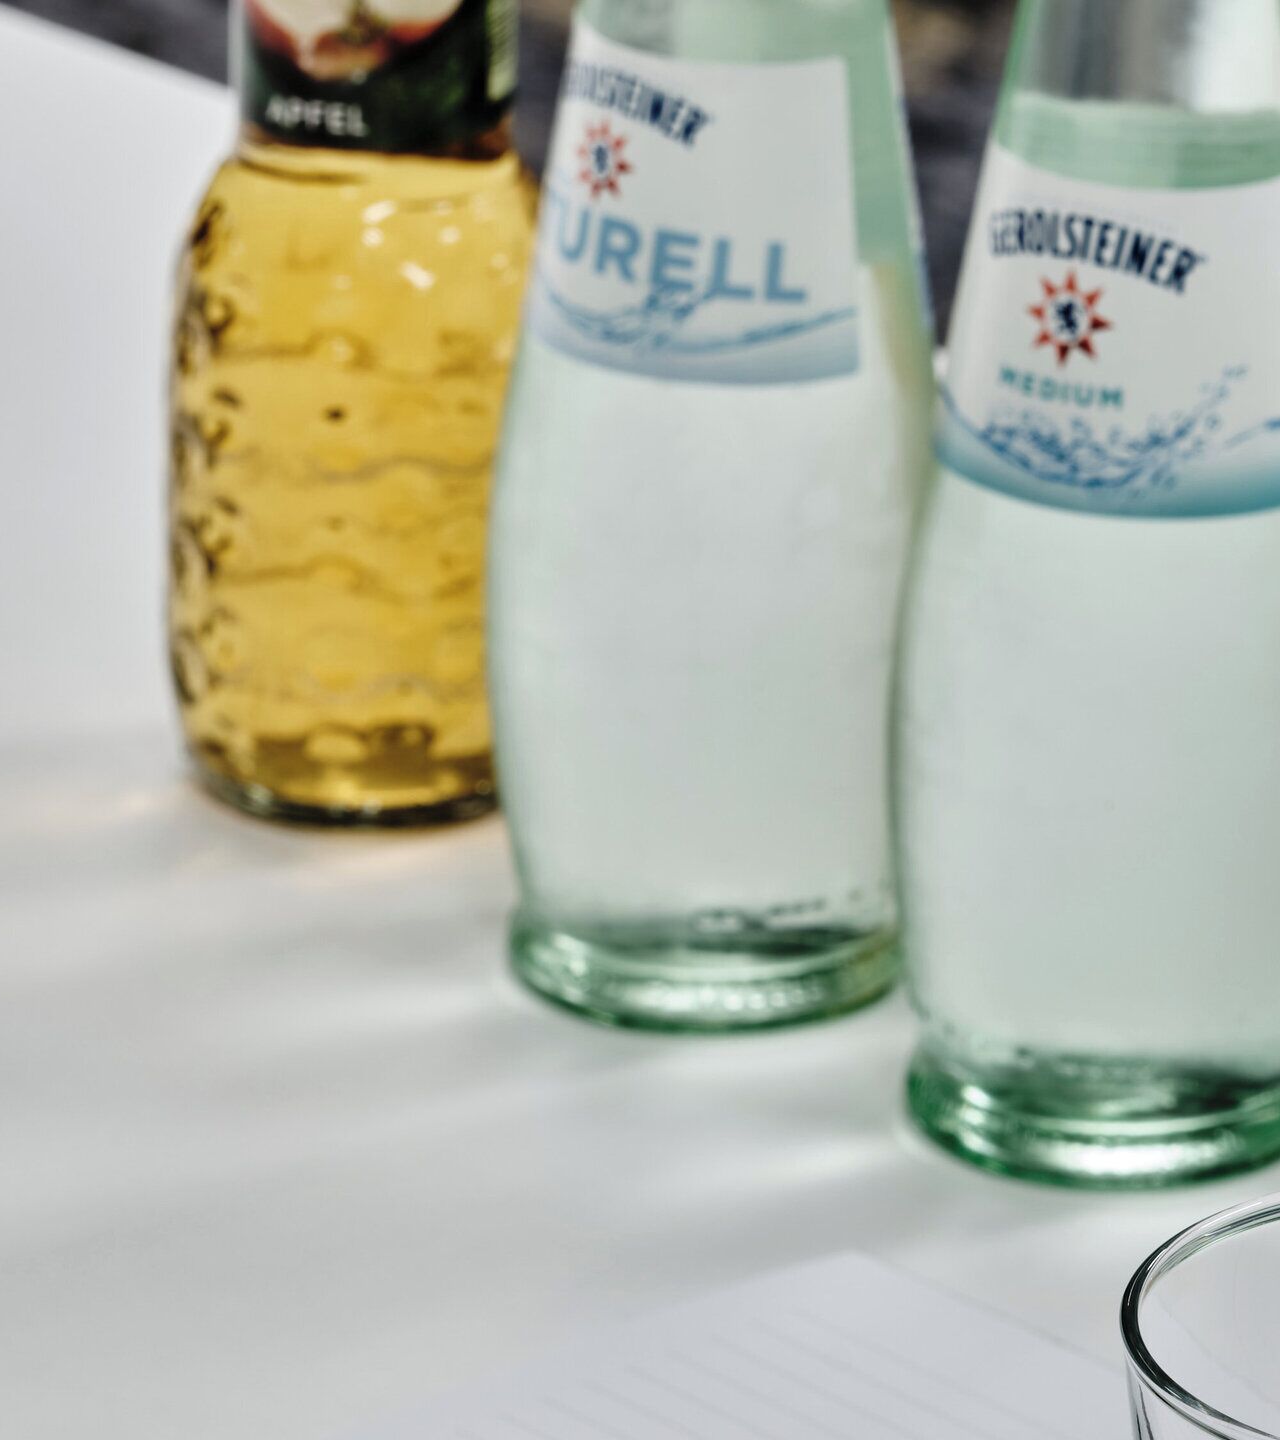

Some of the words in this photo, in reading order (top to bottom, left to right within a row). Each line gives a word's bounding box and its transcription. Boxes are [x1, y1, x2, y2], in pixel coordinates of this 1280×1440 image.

[266, 95, 368, 137] APFEL
[558, 205, 808, 301] URELL
[990, 206, 1200, 294] GEROLSTEINER
[999, 366, 1124, 409] MEDIUM
